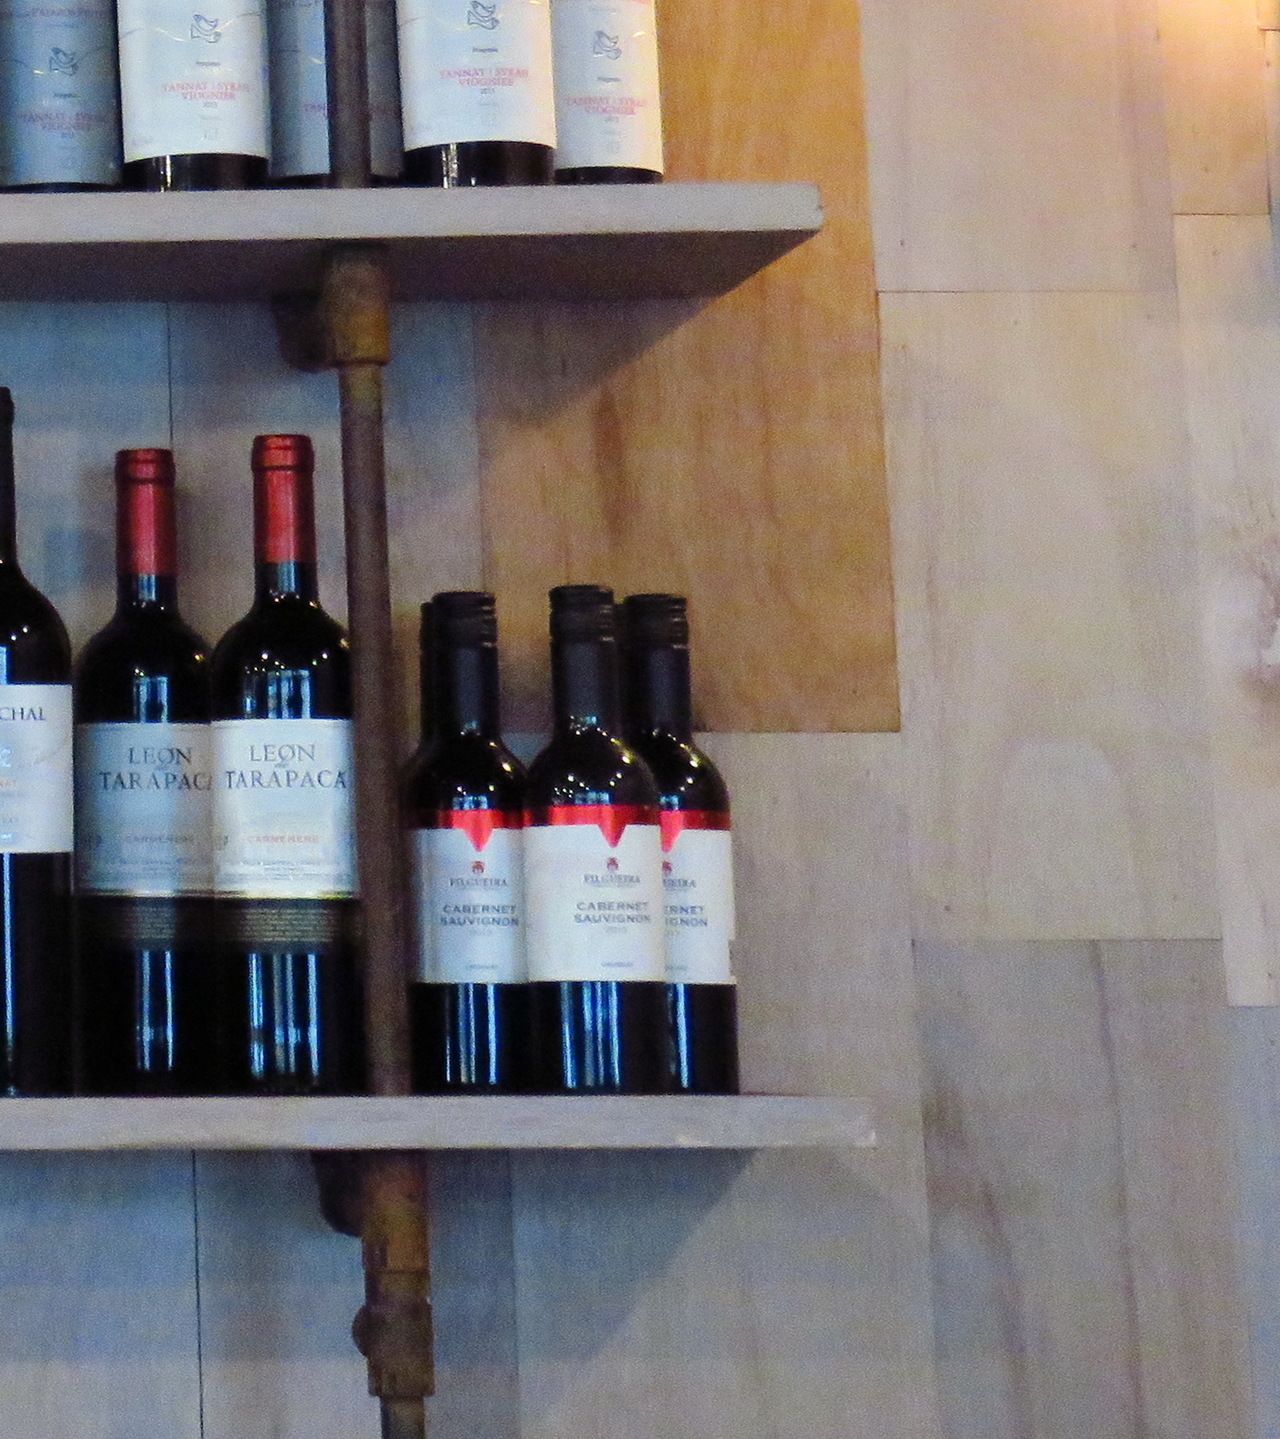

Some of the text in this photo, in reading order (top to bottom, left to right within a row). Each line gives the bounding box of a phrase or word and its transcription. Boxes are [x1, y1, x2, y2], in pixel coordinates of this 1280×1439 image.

[99, 771, 212, 792] TARAPAC
[442, 904, 517, 915] CABERNET
[576, 901, 648, 912] CABERNET
[440, 916, 520, 928] SAUVIGNON
[574, 913, 651, 925] SAUVIGNON
